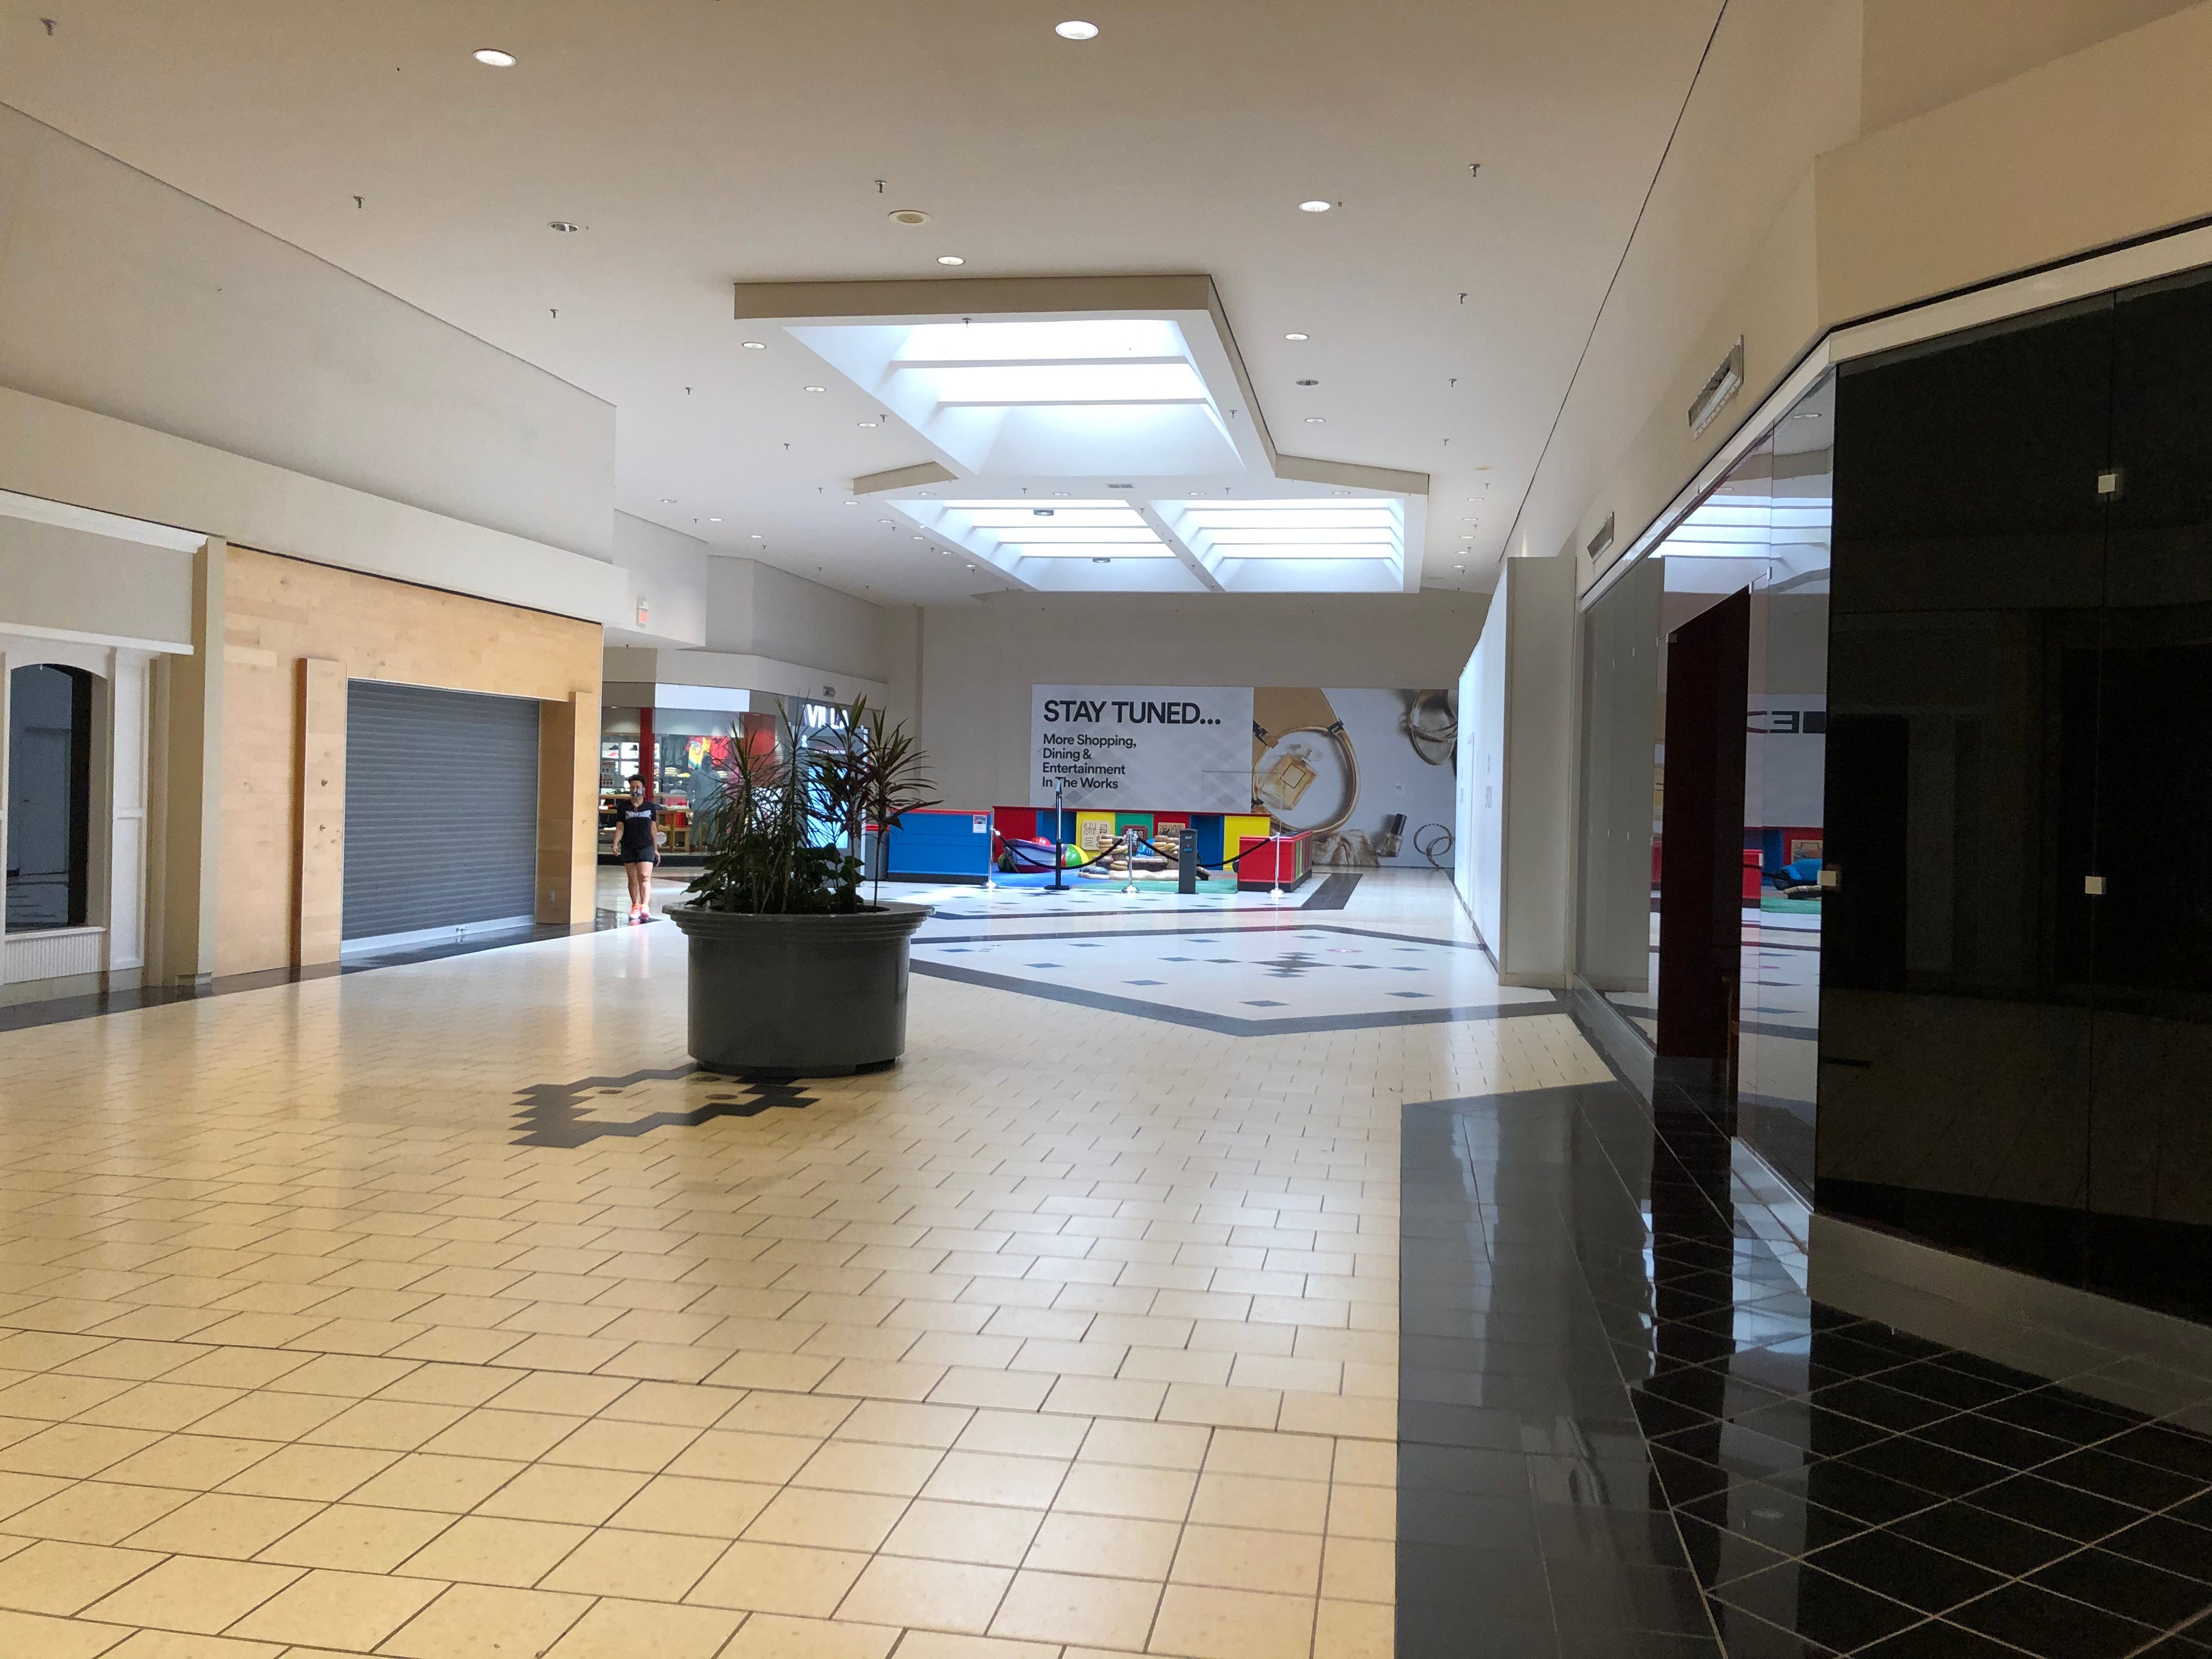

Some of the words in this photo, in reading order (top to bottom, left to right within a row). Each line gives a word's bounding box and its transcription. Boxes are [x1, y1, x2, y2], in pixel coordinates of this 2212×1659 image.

[1043, 699, 1107, 723] STAY
[1111, 701, 1221, 725] TUNED...
[1043, 733, 1075, 745] More
[1077, 733, 1137, 749] Shopping,
[1043, 748, 1080, 761] Dining
[1082, 748, 1092, 760] &
[1042, 762, 1126, 775] Entertainment
[1042, 776, 1053, 787] In
[1055, 776, 1078, 788] The
[1080, 777, 1119, 789] Works
